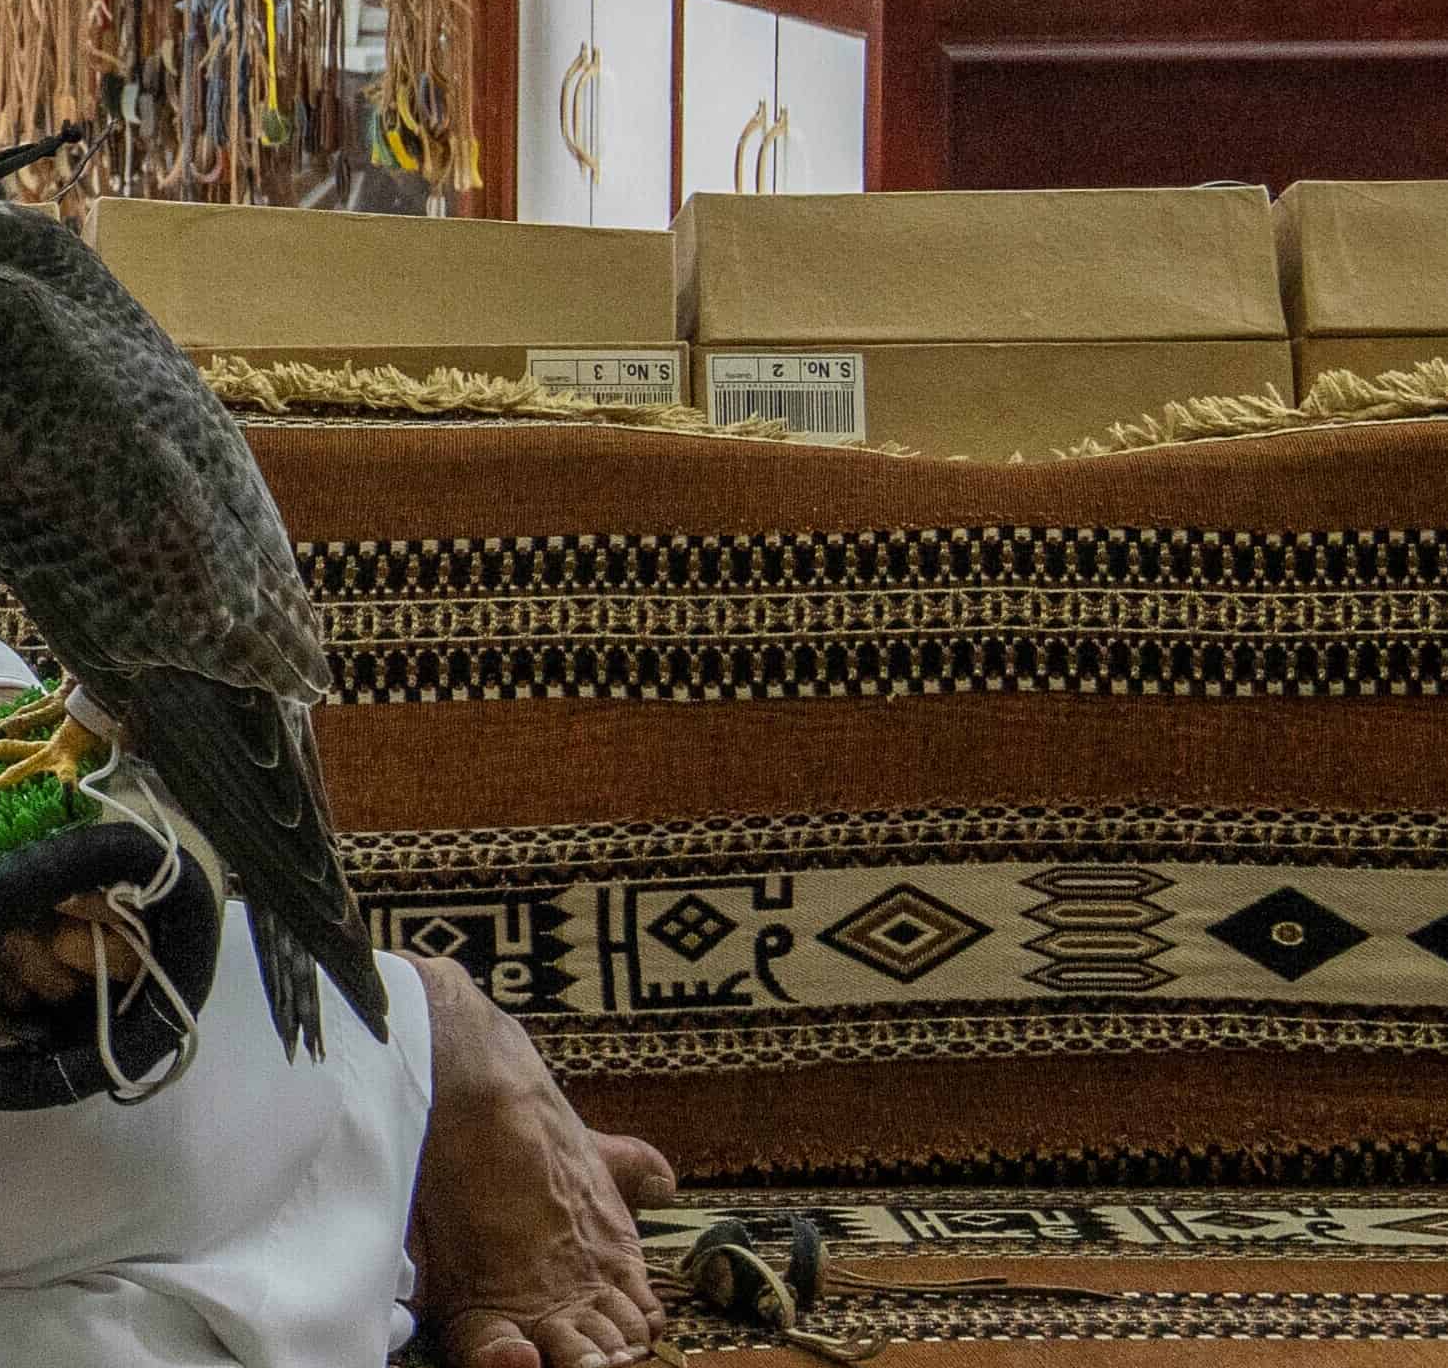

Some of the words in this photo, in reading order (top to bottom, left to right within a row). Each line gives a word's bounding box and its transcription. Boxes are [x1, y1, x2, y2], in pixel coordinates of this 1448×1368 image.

[593, 363, 604, 381] 3
[622, 363, 649, 381] No.
[771, 363, 785, 378] 2
[804, 361, 830, 378] No.
